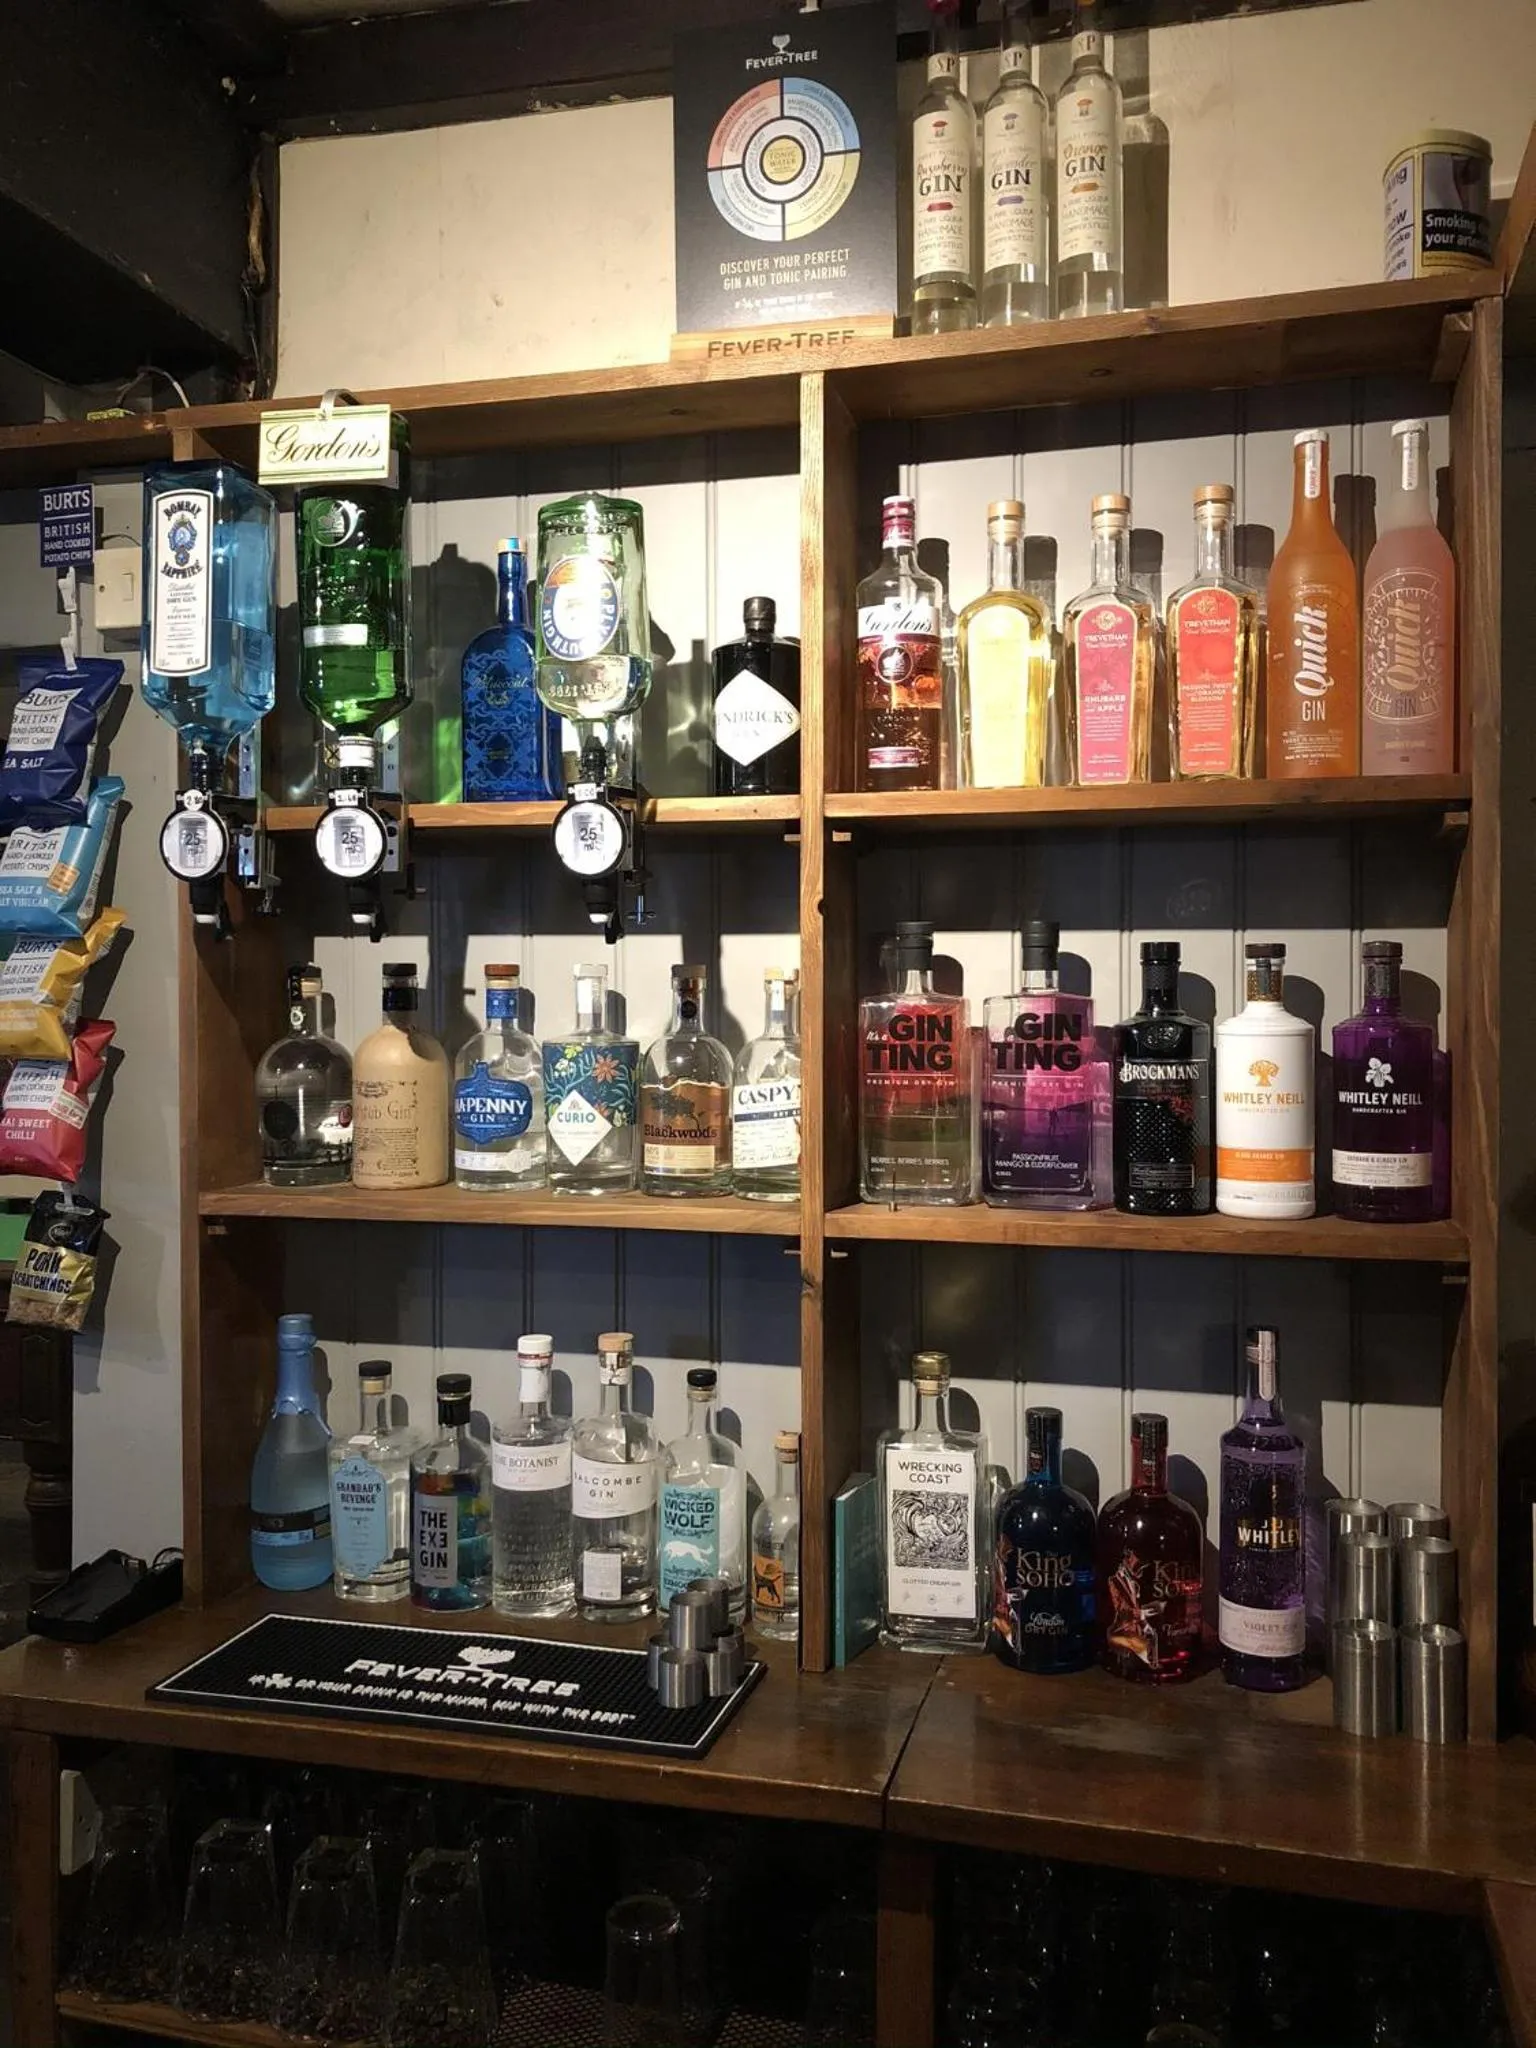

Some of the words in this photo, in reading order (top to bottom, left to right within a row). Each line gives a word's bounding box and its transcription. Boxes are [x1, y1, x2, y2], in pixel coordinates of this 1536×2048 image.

[745, 50, 818, 70] FEVER-TREE
[1065, 155, 1107, 177] GIN
[919, 173, 962, 196] GIN
[990, 168, 1032, 190] GIN
[1425, 233, 1456, 247] your
[720, 257, 770, 276] DISCOVER
[773, 254, 801, 269] YOUR
[804, 247, 850, 266] PERFECT
[723, 278, 743, 291] GIN
[745, 274, 767, 289] AND
[770, 270, 801, 285] TONIC
[804, 264, 848, 281] PAIRING
[707, 329, 856, 358] FEVER-TREE
[264, 423, 384, 466] Gordon's
[43, 489, 91, 512] BURTS
[163, 500, 203, 520] BOMBAY
[44, 522, 91, 538] BRITISH
[43, 540, 63, 550] HAND
[64, 537, 91, 549] COOKED
[43, 552, 70, 563] POTATO
[70, 549, 91, 560] CHIPS
[1302, 699, 1326, 722] GIN
[3, 758, 17, 769] EA
[20, 757, 45, 769] SALT
[185, 833, 201, 846] 25
[341, 831, 359, 845] 25
[579, 827, 598, 842] 25
[888, 1013, 953, 1042] GIN
[1014, 1012, 1082, 1042] GIN
[866, 1043, 953, 1072] TING
[990, 1041, 1082, 1072] TING
[1119, 1056, 1200, 1082] BROCKMANS
[738, 1084, 801, 1106] CASPY
[1223, 1091, 1273, 1105] WHITLEY
[1276, 1092, 1305, 1105] NEILL
[1338, 1091, 1389, 1105] WHITLEY
[1392, 1093, 1423, 1106] NEILL
[18, 1118, 53, 1129] SWEET
[469, 1113, 496, 1123] GIN
[556, 1112, 597, 1124] CURIO
[5, 1130, 36, 1140] CHILLI
[643, 1123, 718, 1138] Blackwoods
[508, 1456, 560, 1469] BOTANIST
[898, 1461, 962, 1474] WRECKING
[909, 1472, 951, 1485] COAST
[340, 1493, 376, 1504] REVENGE
[589, 1488, 614, 1498] GIN
[664, 1498, 715, 1514] WICKED
[420, 1510, 448, 1529] THE
[664, 1510, 711, 1529] WOLF
[1237, 1526, 1301, 1548] WHITLEY
[420, 1550, 448, 1569] GIN
[1016, 1547, 1073, 1572] King
[344, 1659, 581, 1697] FEVER-TREE
[351, 1684, 397, 1699] DRINK
